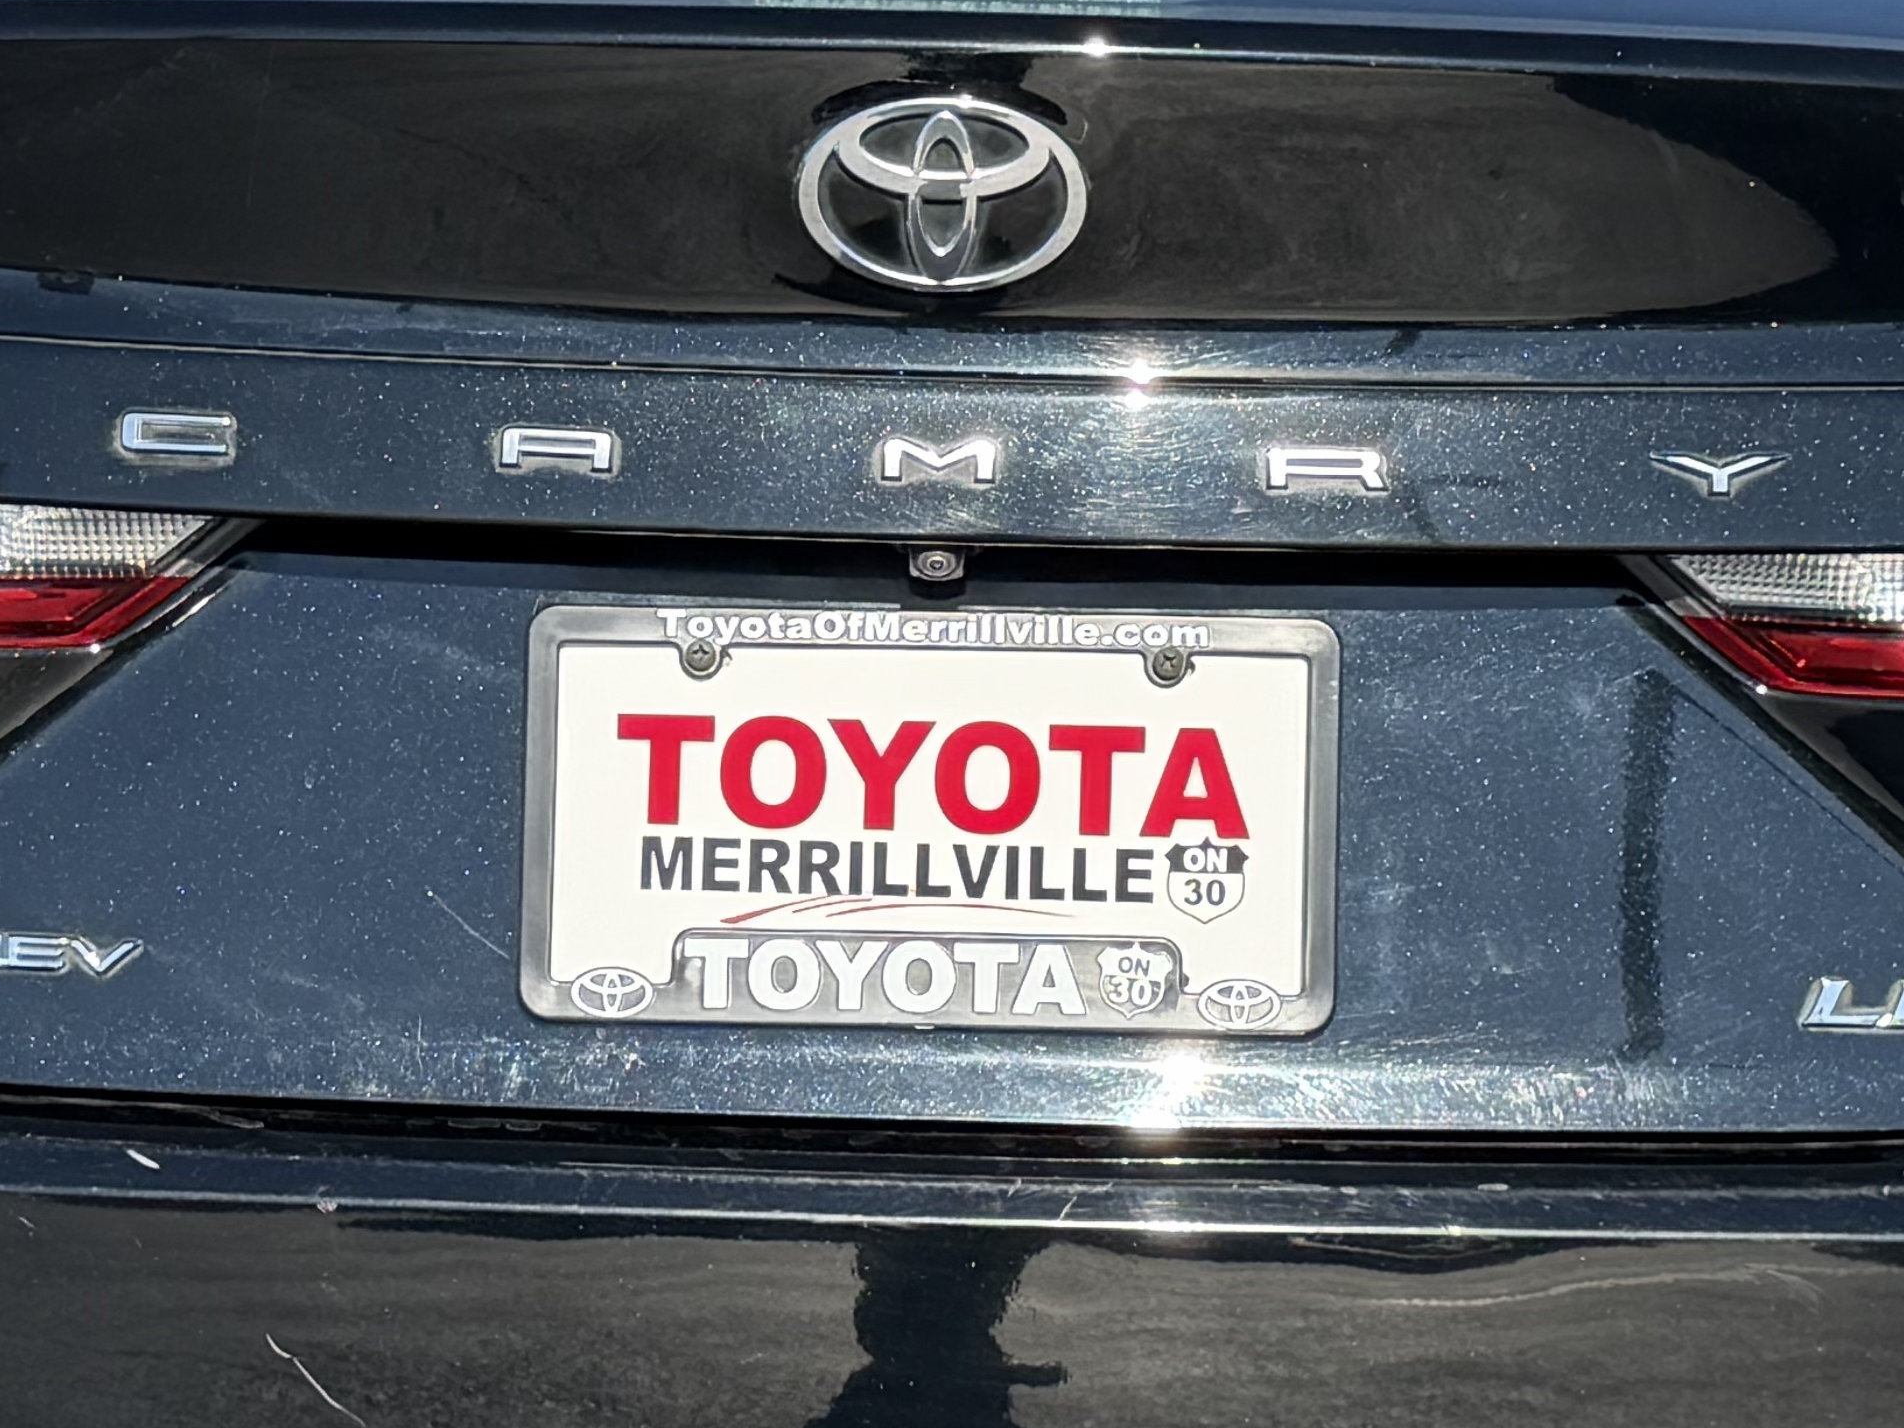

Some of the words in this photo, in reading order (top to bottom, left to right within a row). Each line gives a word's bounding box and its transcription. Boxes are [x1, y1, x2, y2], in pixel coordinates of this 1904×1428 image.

[114, 410, 1792, 498] CAMRY
[656, 608, 1211, 648] ToyotaOfMerrillville.com
[617, 713, 1250, 840] TOYOTA
[640, 836, 1154, 904] MERRILLVILLE
[1183, 847, 1228, 873] ON
[1183, 878, 1226, 906] 30
[685, 938, 1086, 1014] TOYOTA
[1118, 956, 1150, 977] ON
[1108, 976, 1152, 1007] 30
